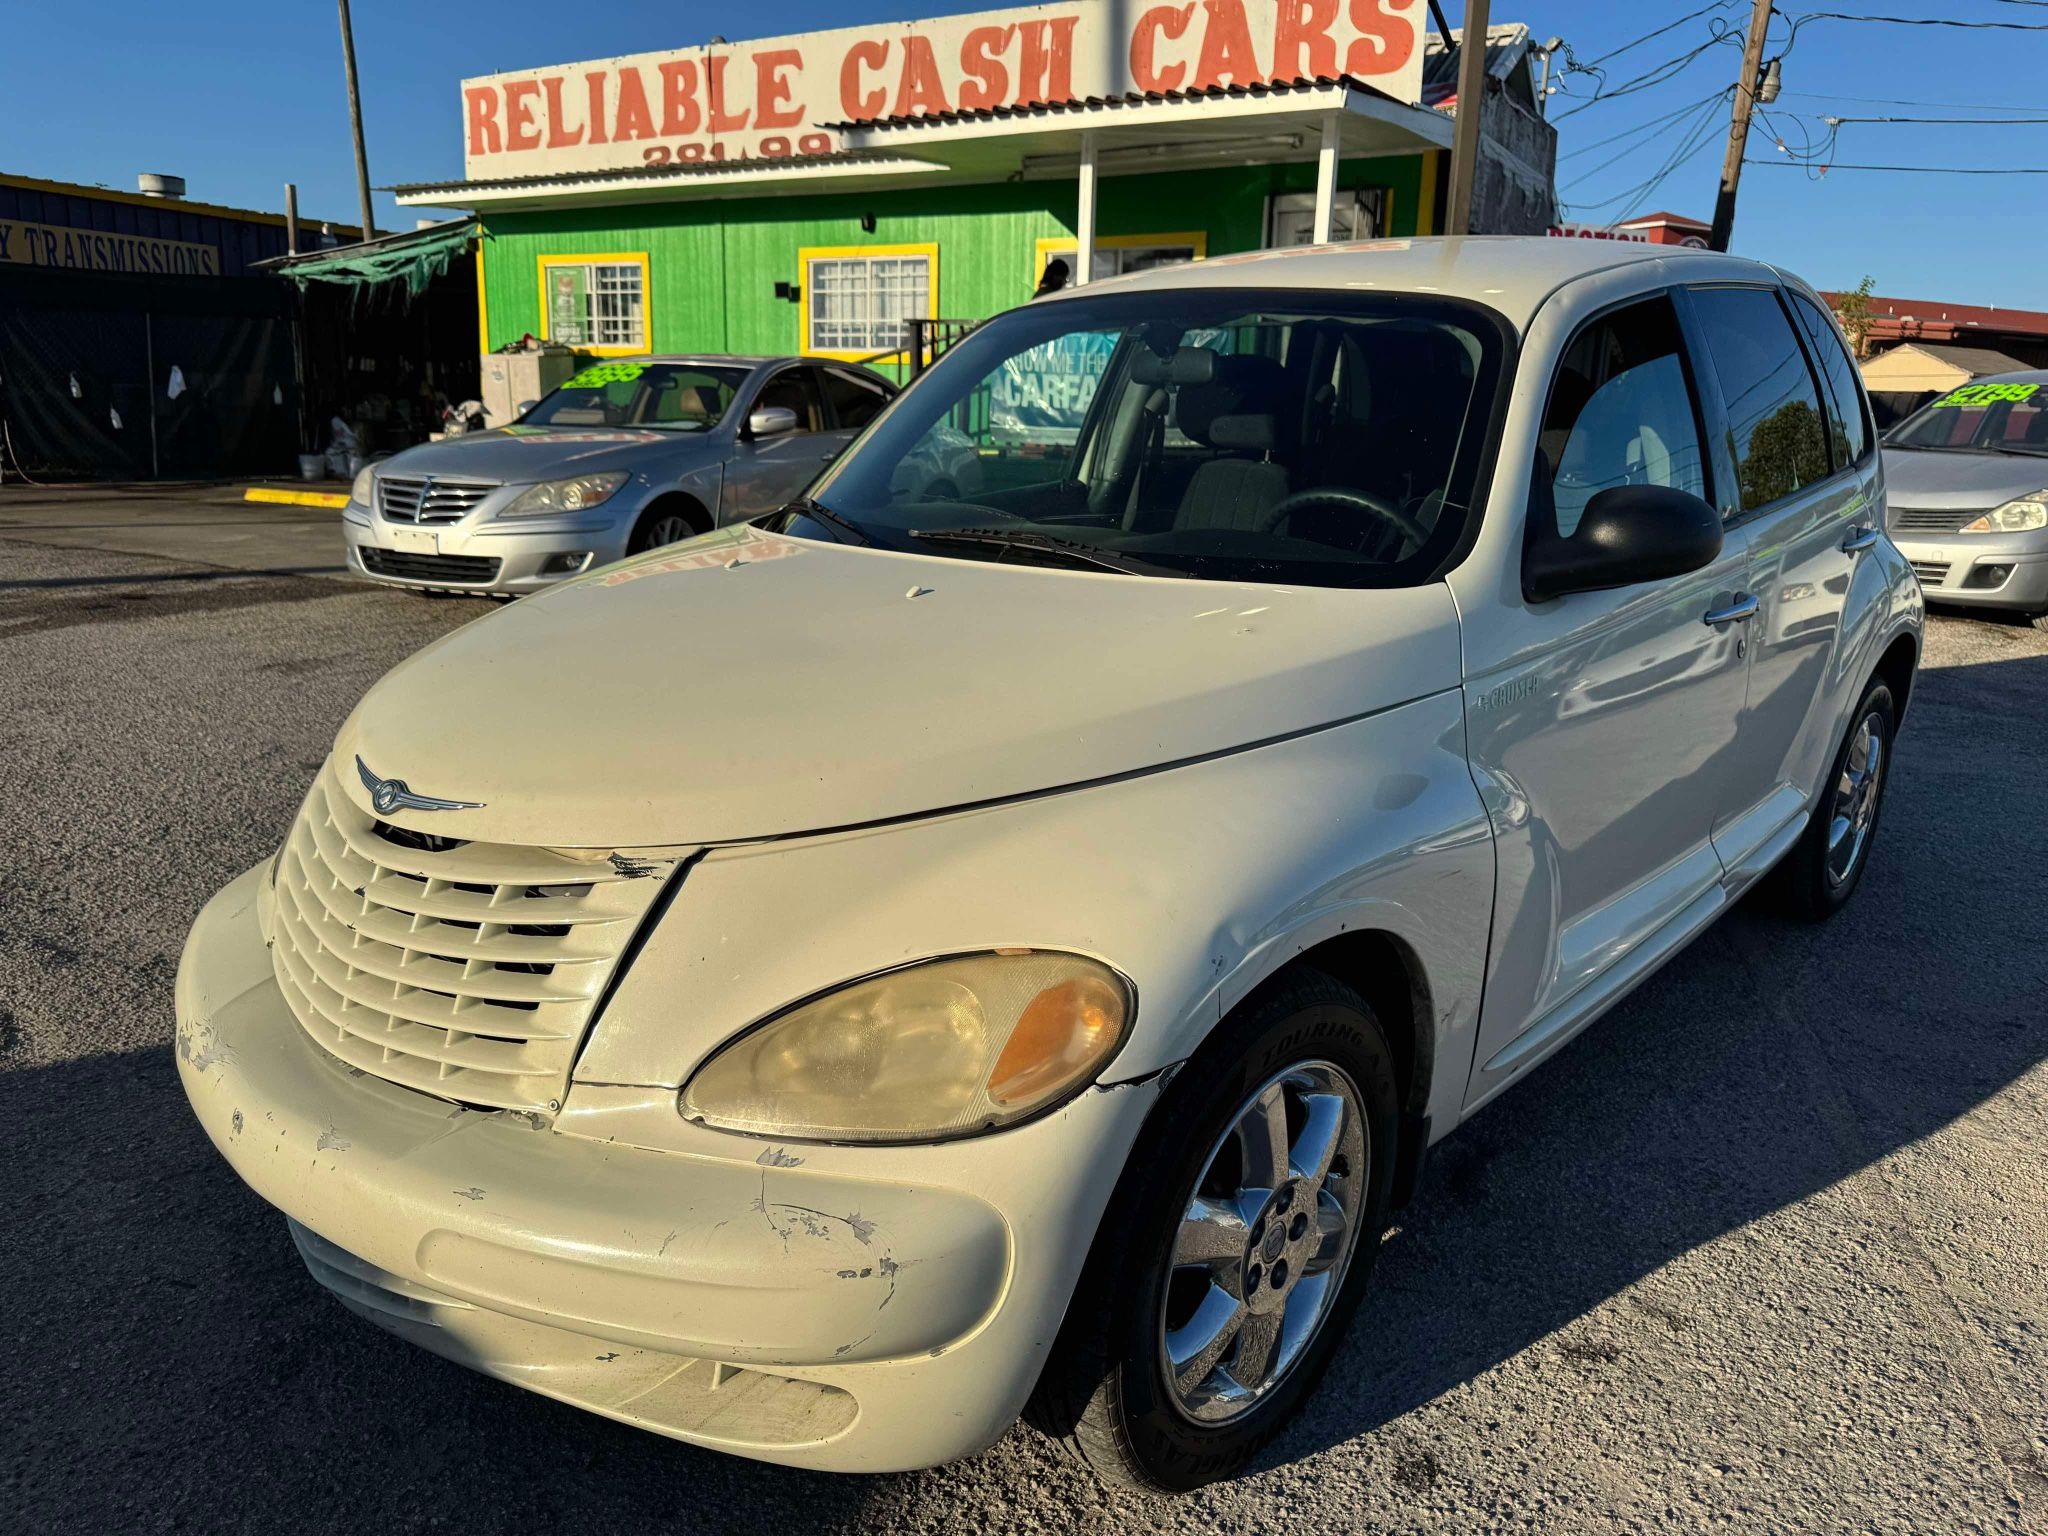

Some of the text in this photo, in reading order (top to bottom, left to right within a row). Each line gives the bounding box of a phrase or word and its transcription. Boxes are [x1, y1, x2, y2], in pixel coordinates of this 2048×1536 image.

[464, 0, 1416, 156] RELIABLE CASH CARS
[24, 227, 213, 276] TRANSMISSIONS
[1003, 372, 1098, 412] CARFA
[1262, 1021, 1364, 1067] TOURING
